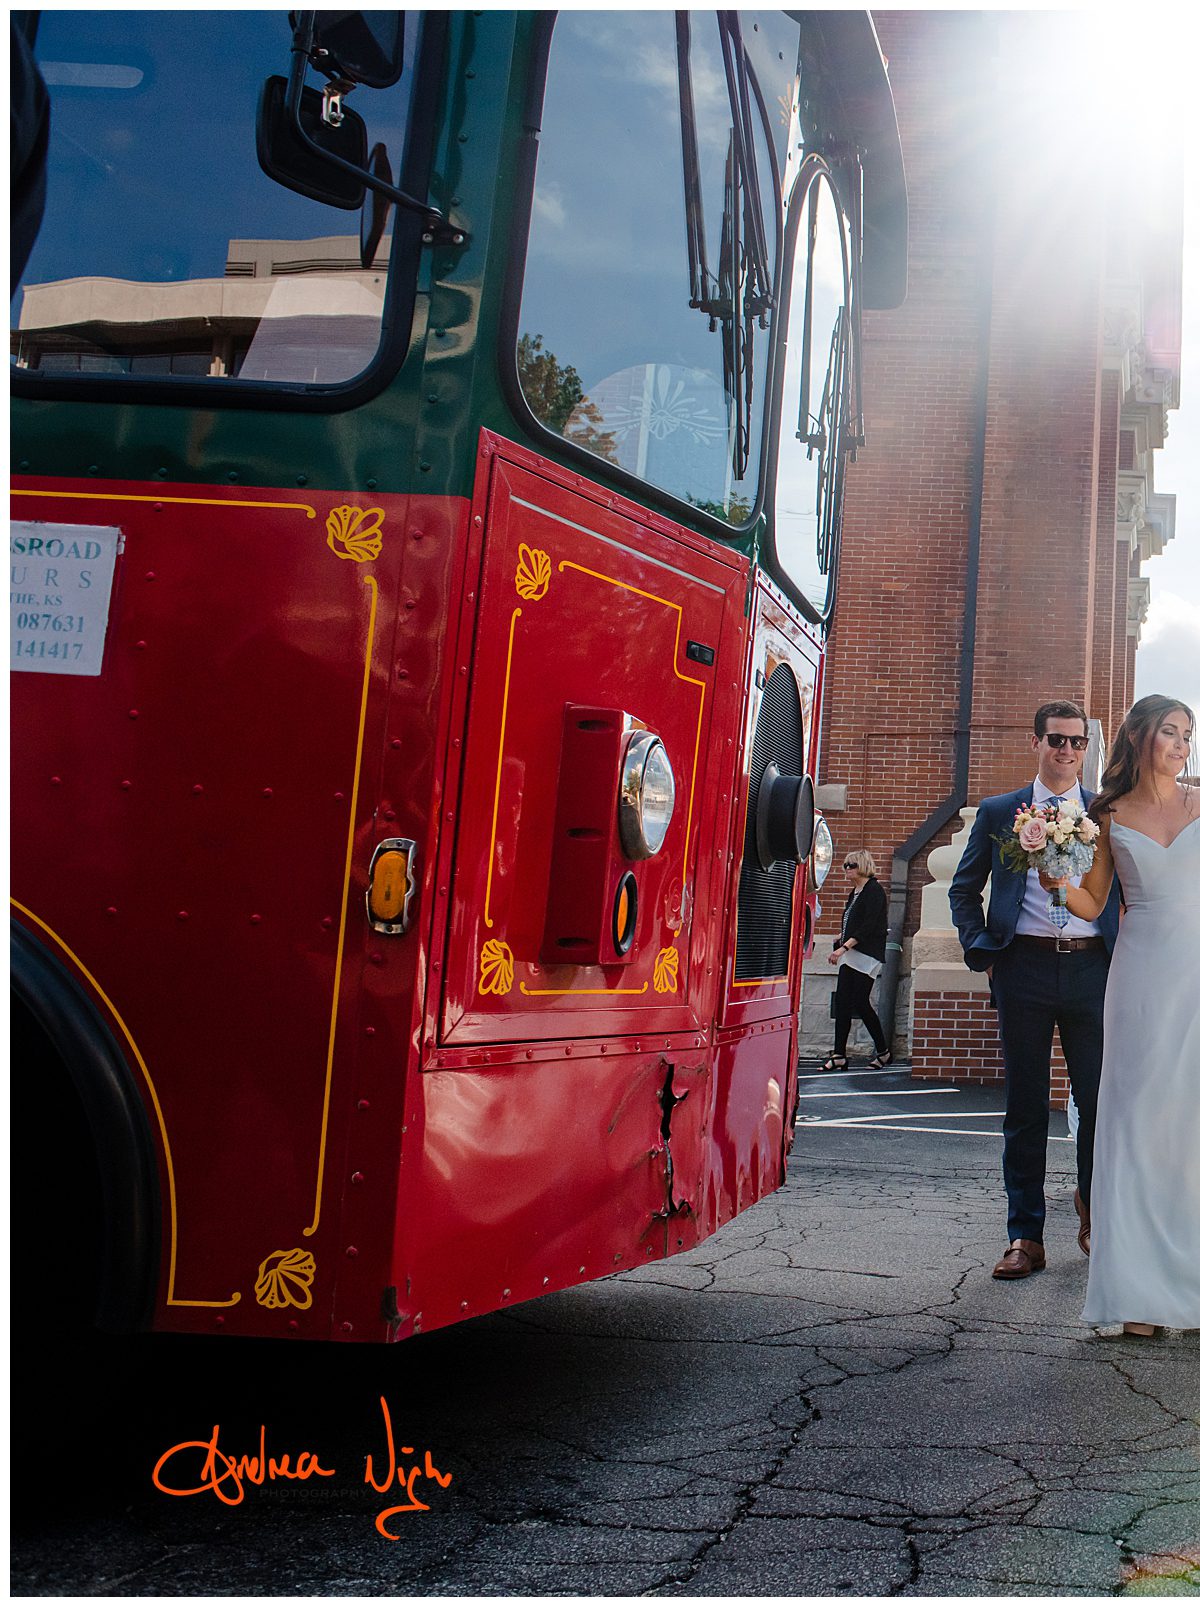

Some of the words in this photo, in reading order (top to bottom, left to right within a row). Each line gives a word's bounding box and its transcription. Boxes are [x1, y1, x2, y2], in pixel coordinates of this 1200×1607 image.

[10, 537, 101, 560] SROAD
[44, 594, 63, 606] KS
[17, 612, 84, 633] 087631
[15, 640, 83, 660] 141417
